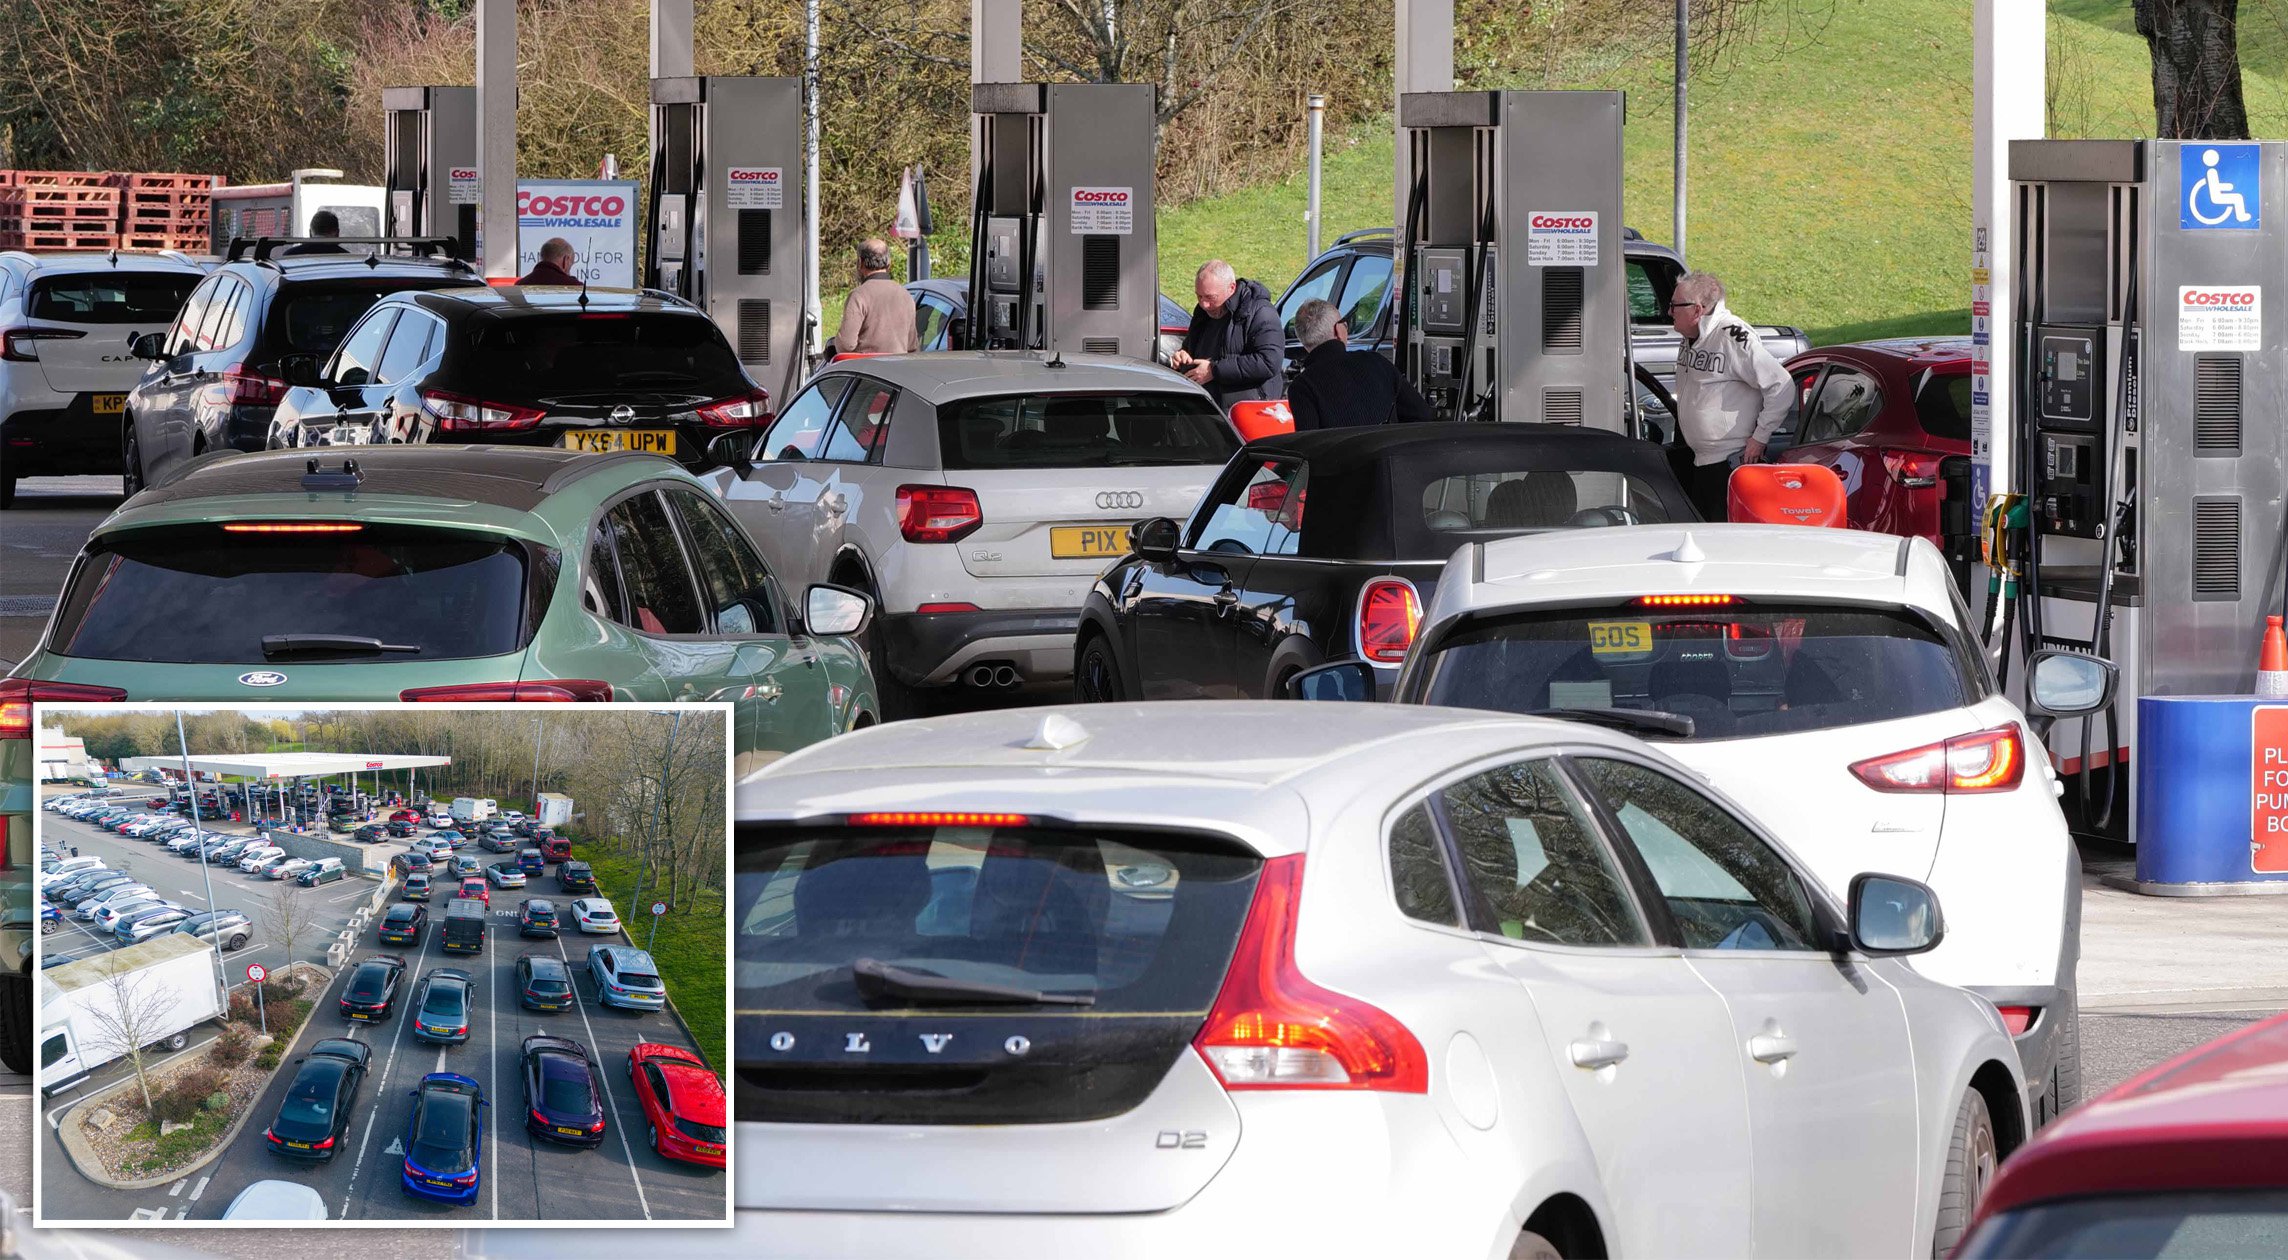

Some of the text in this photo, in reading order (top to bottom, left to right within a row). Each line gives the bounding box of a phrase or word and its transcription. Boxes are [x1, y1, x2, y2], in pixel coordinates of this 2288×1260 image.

[730, 170, 779, 180] COSTCO
[1074, 190, 1128, 201] COSTCO
[518, 191, 625, 217] COSTCO
[545, 218, 622, 228] WHOLESALE
[1532, 215, 1593, 228] COSTCO
[595, 252, 624, 264] FOR
[2183, 290, 2255, 305] COSTCO
[103, 396, 128, 411] KP
[630, 433, 668, 452] UPW
[1780, 507, 1823, 515] Towels
[972, 550, 1003, 562] Q2
[2264, 747, 2288, 764] PL
[2264, 770, 2288, 787] FO
[769, 1031, 1031, 1056] OLVO
[1156, 1130, 1208, 1149] D2
